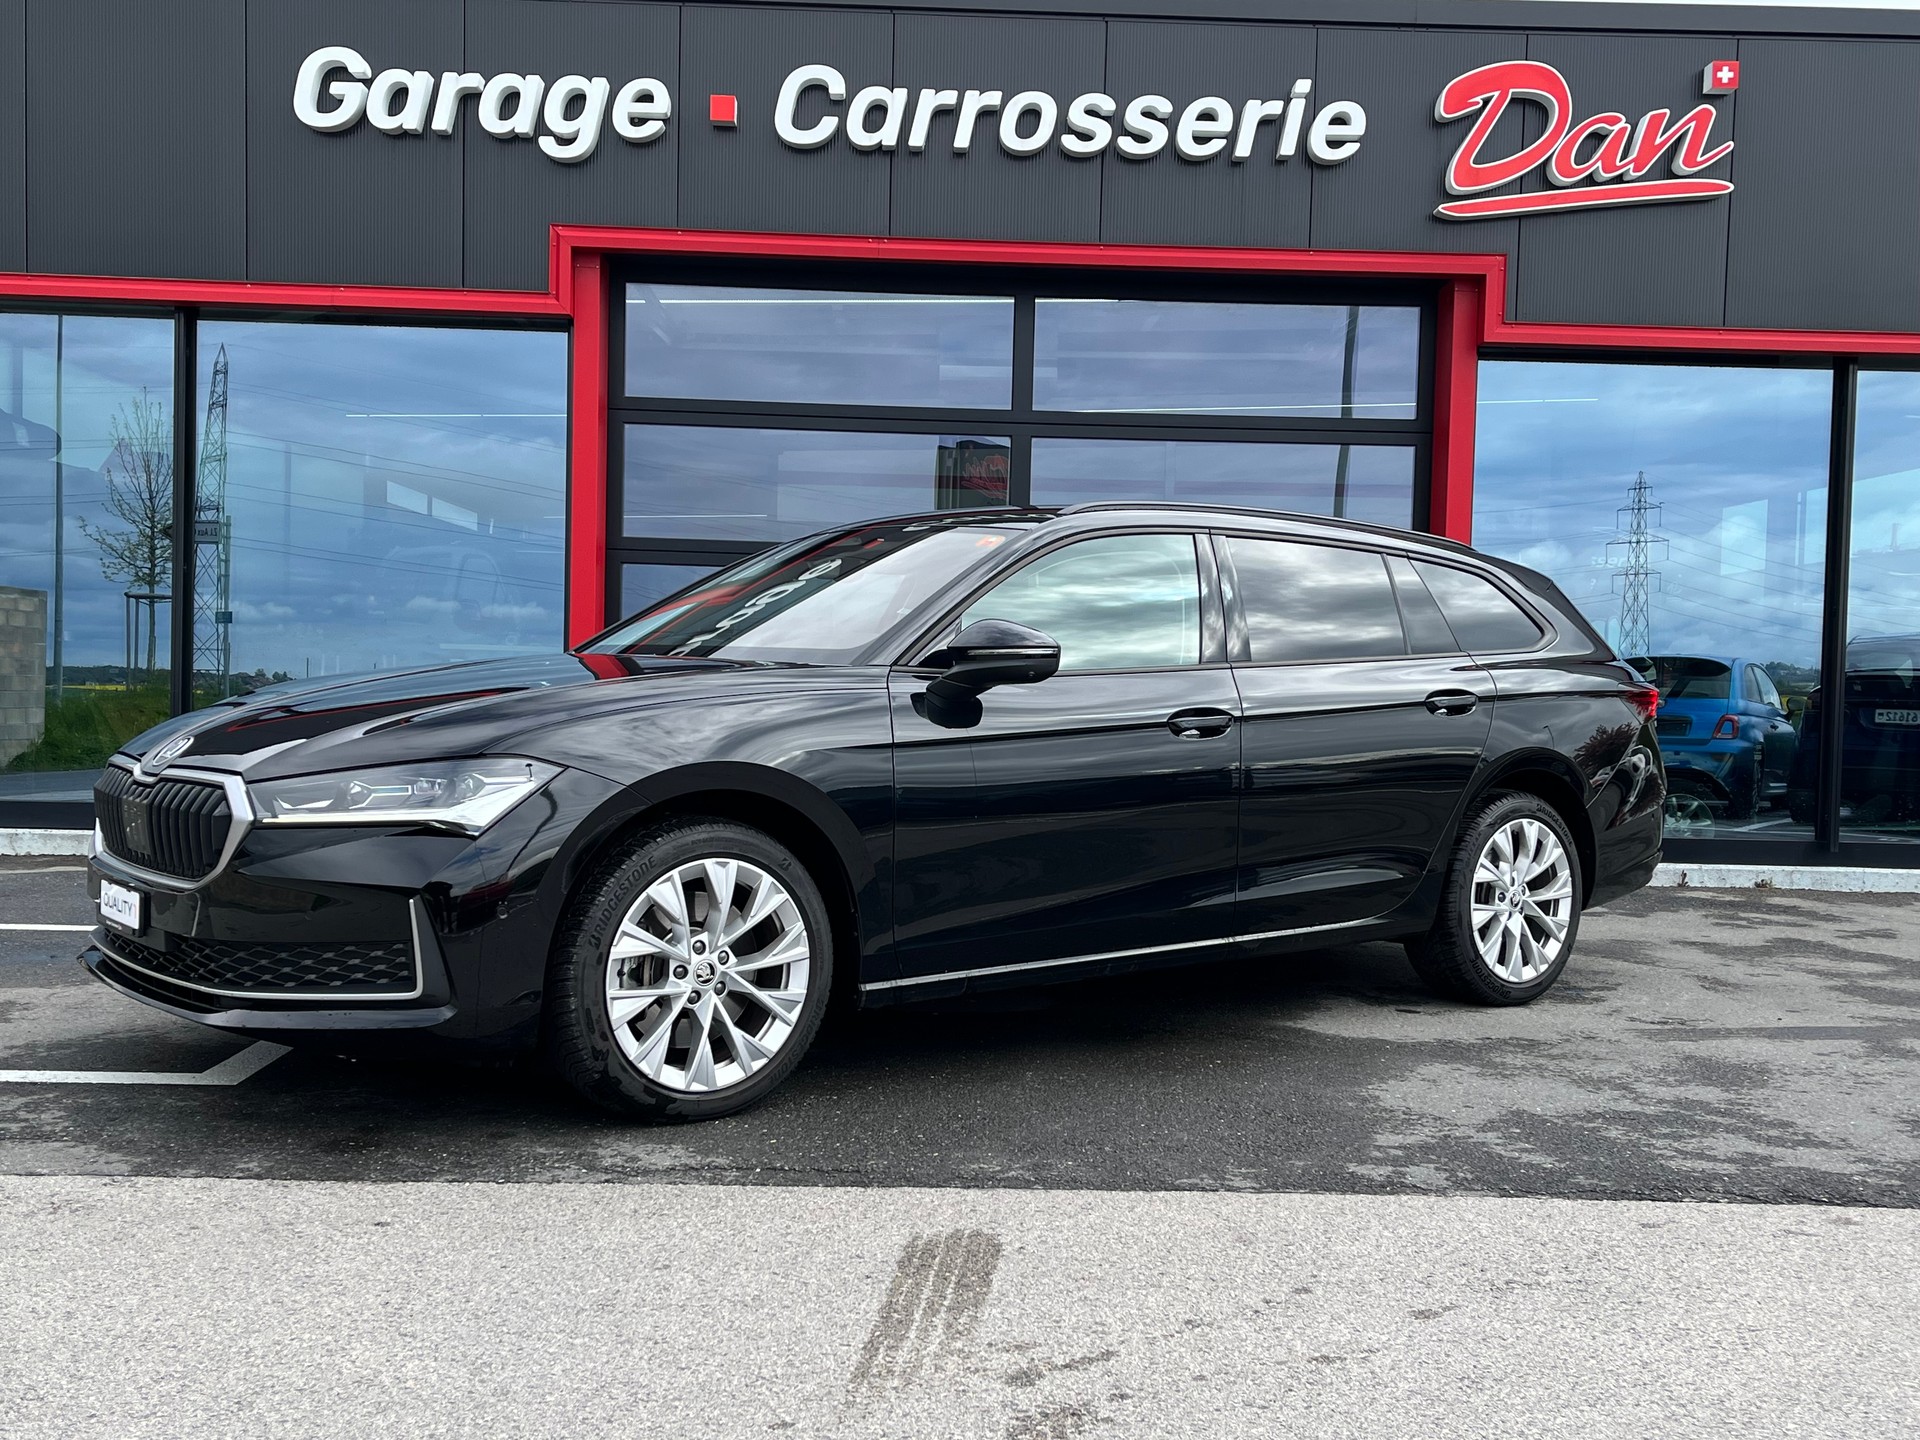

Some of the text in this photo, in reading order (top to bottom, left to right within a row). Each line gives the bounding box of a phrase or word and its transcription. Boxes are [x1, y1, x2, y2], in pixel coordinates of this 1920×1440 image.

[292, 45, 672, 164] Garage
[774, 64, 1367, 165] Carrosserie
[1535, 803, 1574, 848] BRIDGESTONE
[587, 855, 659, 951] BRIDGESTONE
[1469, 958, 1513, 1000] BRIDGESTONE
